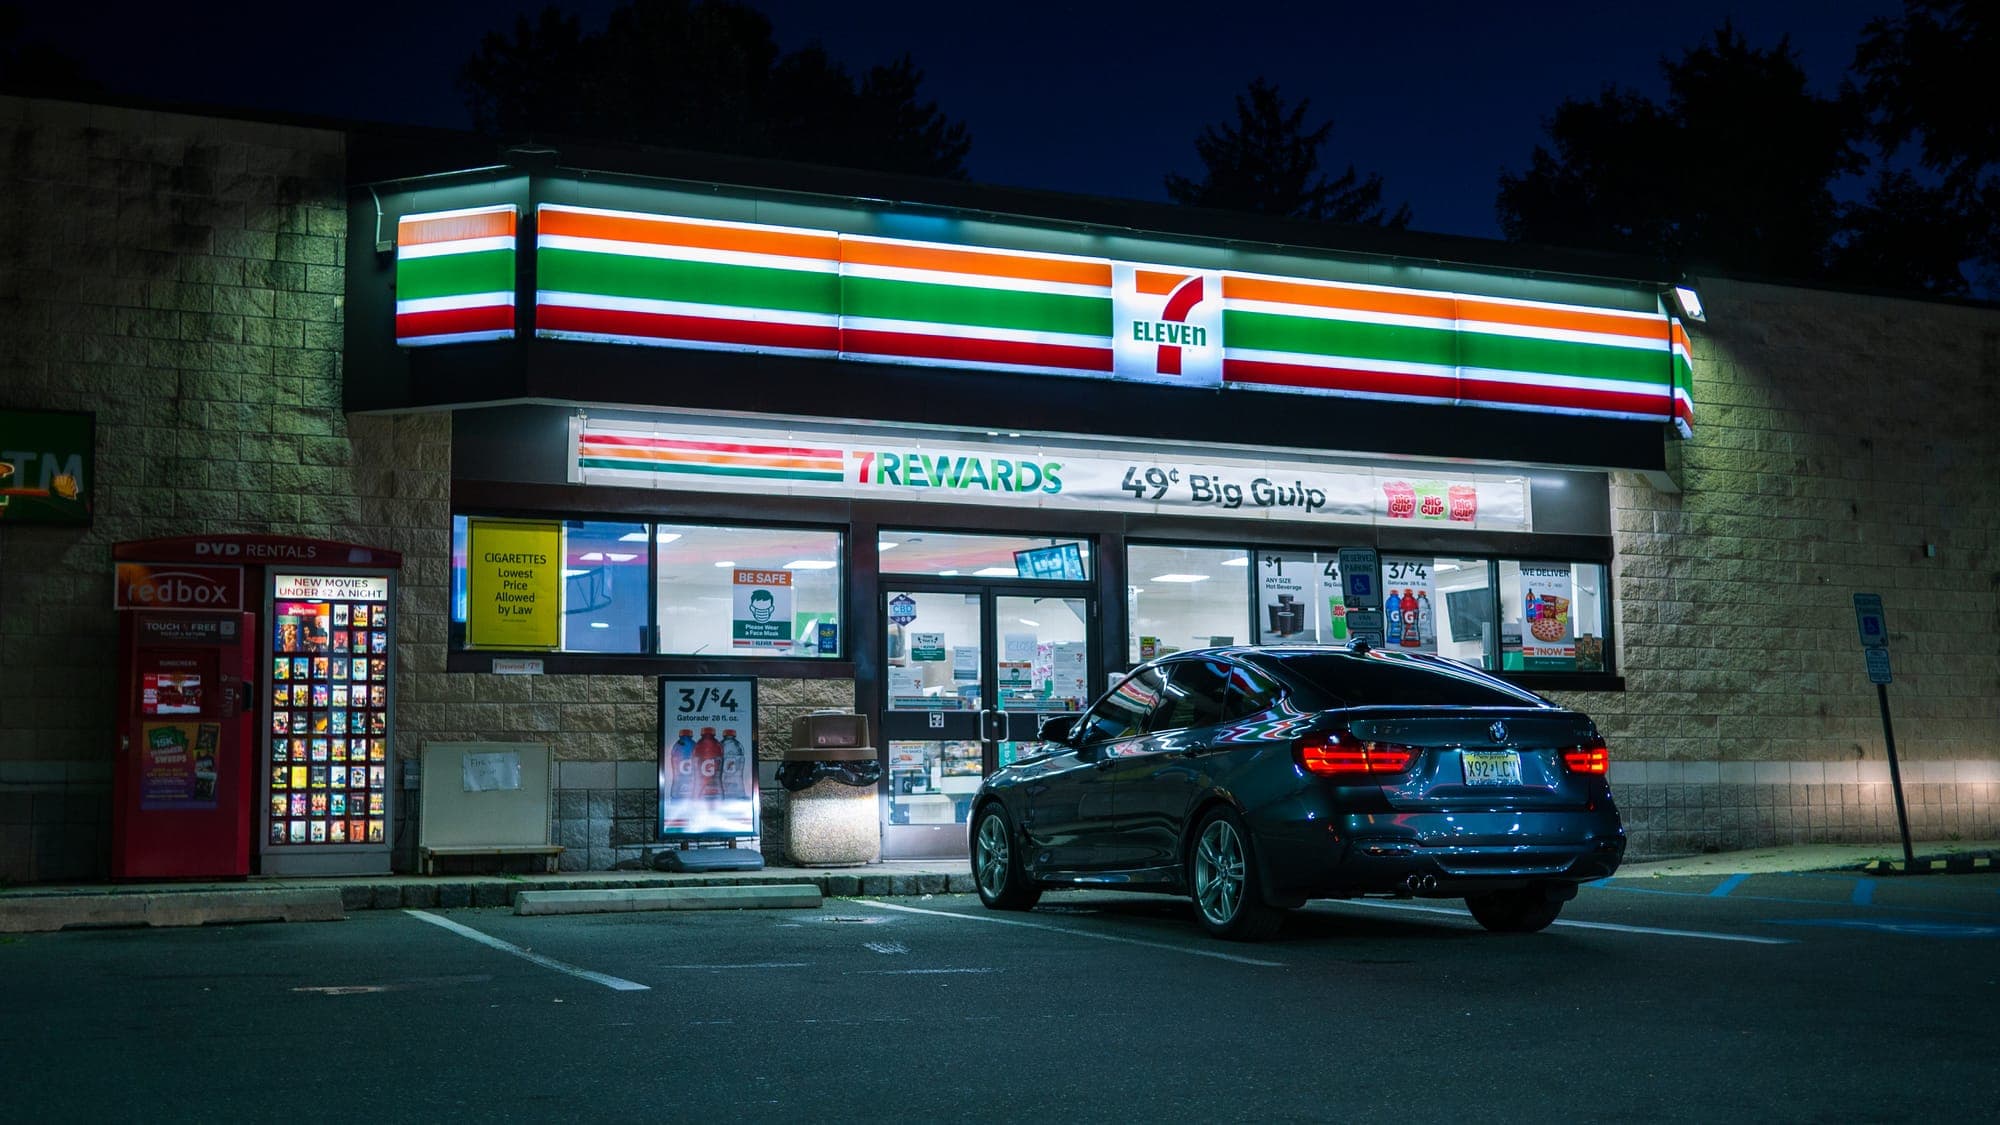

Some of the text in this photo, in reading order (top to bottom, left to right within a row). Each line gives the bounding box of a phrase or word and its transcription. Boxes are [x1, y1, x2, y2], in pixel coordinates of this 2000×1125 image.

[1134, 269, 1204, 376] 7
[1, 450, 85, 494] TM
[852, 451, 1064, 495] 7REWARDS
[1121, 466, 1327, 513] 49¢ Big Gulp
[1424, 496, 1442, 505] BIG
[1392, 503, 1413, 512] GULP
[1421, 505, 1444, 515] GULP
[1453, 508, 1475, 517] GULP
[195, 541, 317, 559] DVD RENTALS
[484, 552, 548, 565] CIGARETTES
[1265, 556, 1282, 577] $1
[1388, 561, 1427, 580] 3/$4
[1520, 567, 1570, 578] WE DELIVER
[498, 567, 534, 579] Lowest
[738, 572, 787, 584] BE SAFE
[294, 578, 369, 589] NEW MOVIES
[503, 580, 529, 591] Price
[126, 578, 228, 605] redbox
[279, 587, 319, 597] UNDER
[337, 589, 347, 598] A
[351, 589, 383, 599] NIGHT
[495, 592, 536, 603] Allowed
[498, 604, 534, 616] by Law
[145, 622, 181, 632] TOUCH
[191, 622, 217, 632] FREE
[678, 687, 739, 713] 3/$4
